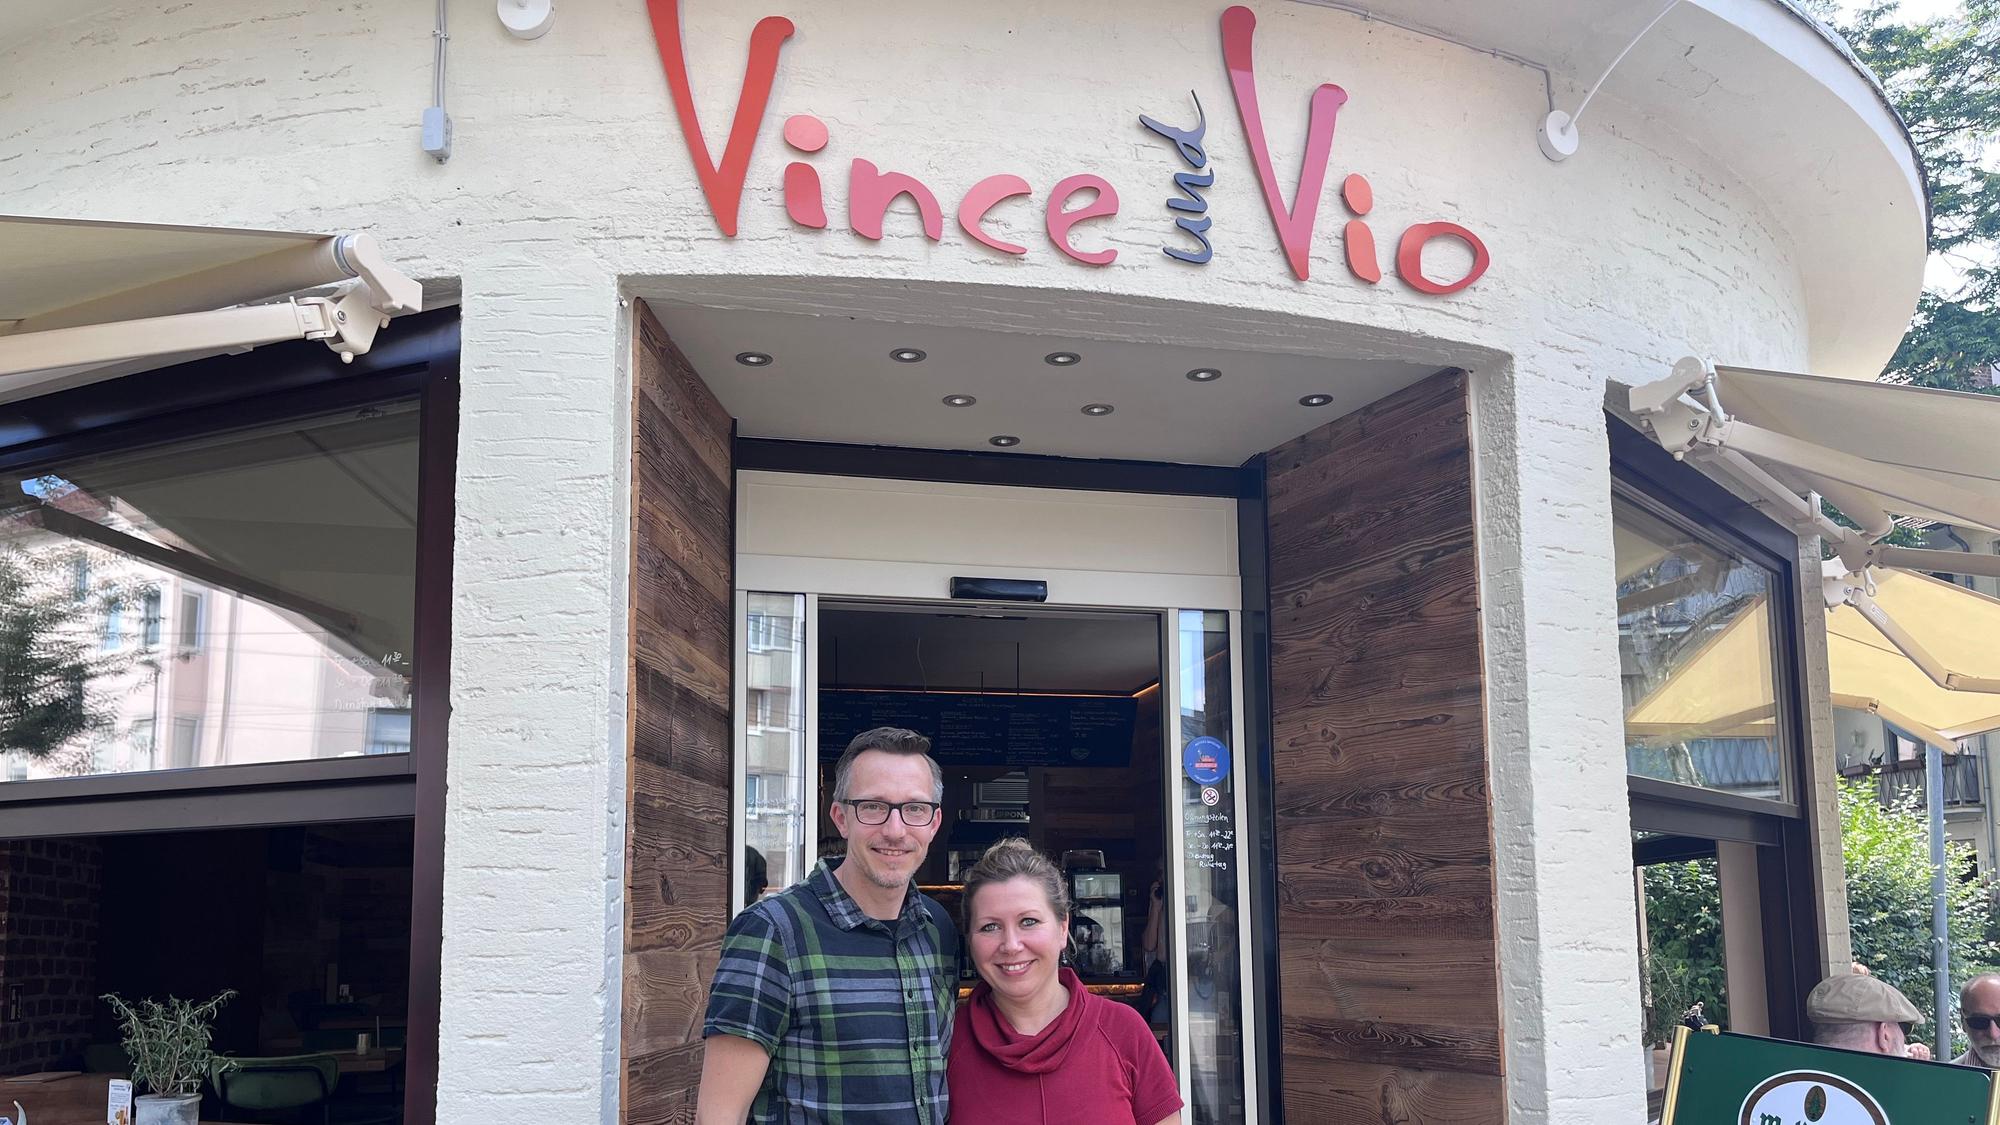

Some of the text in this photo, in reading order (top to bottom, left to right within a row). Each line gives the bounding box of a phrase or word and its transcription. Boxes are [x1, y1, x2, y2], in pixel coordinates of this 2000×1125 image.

[647, 0, 1490, 295] Vince und Vio
